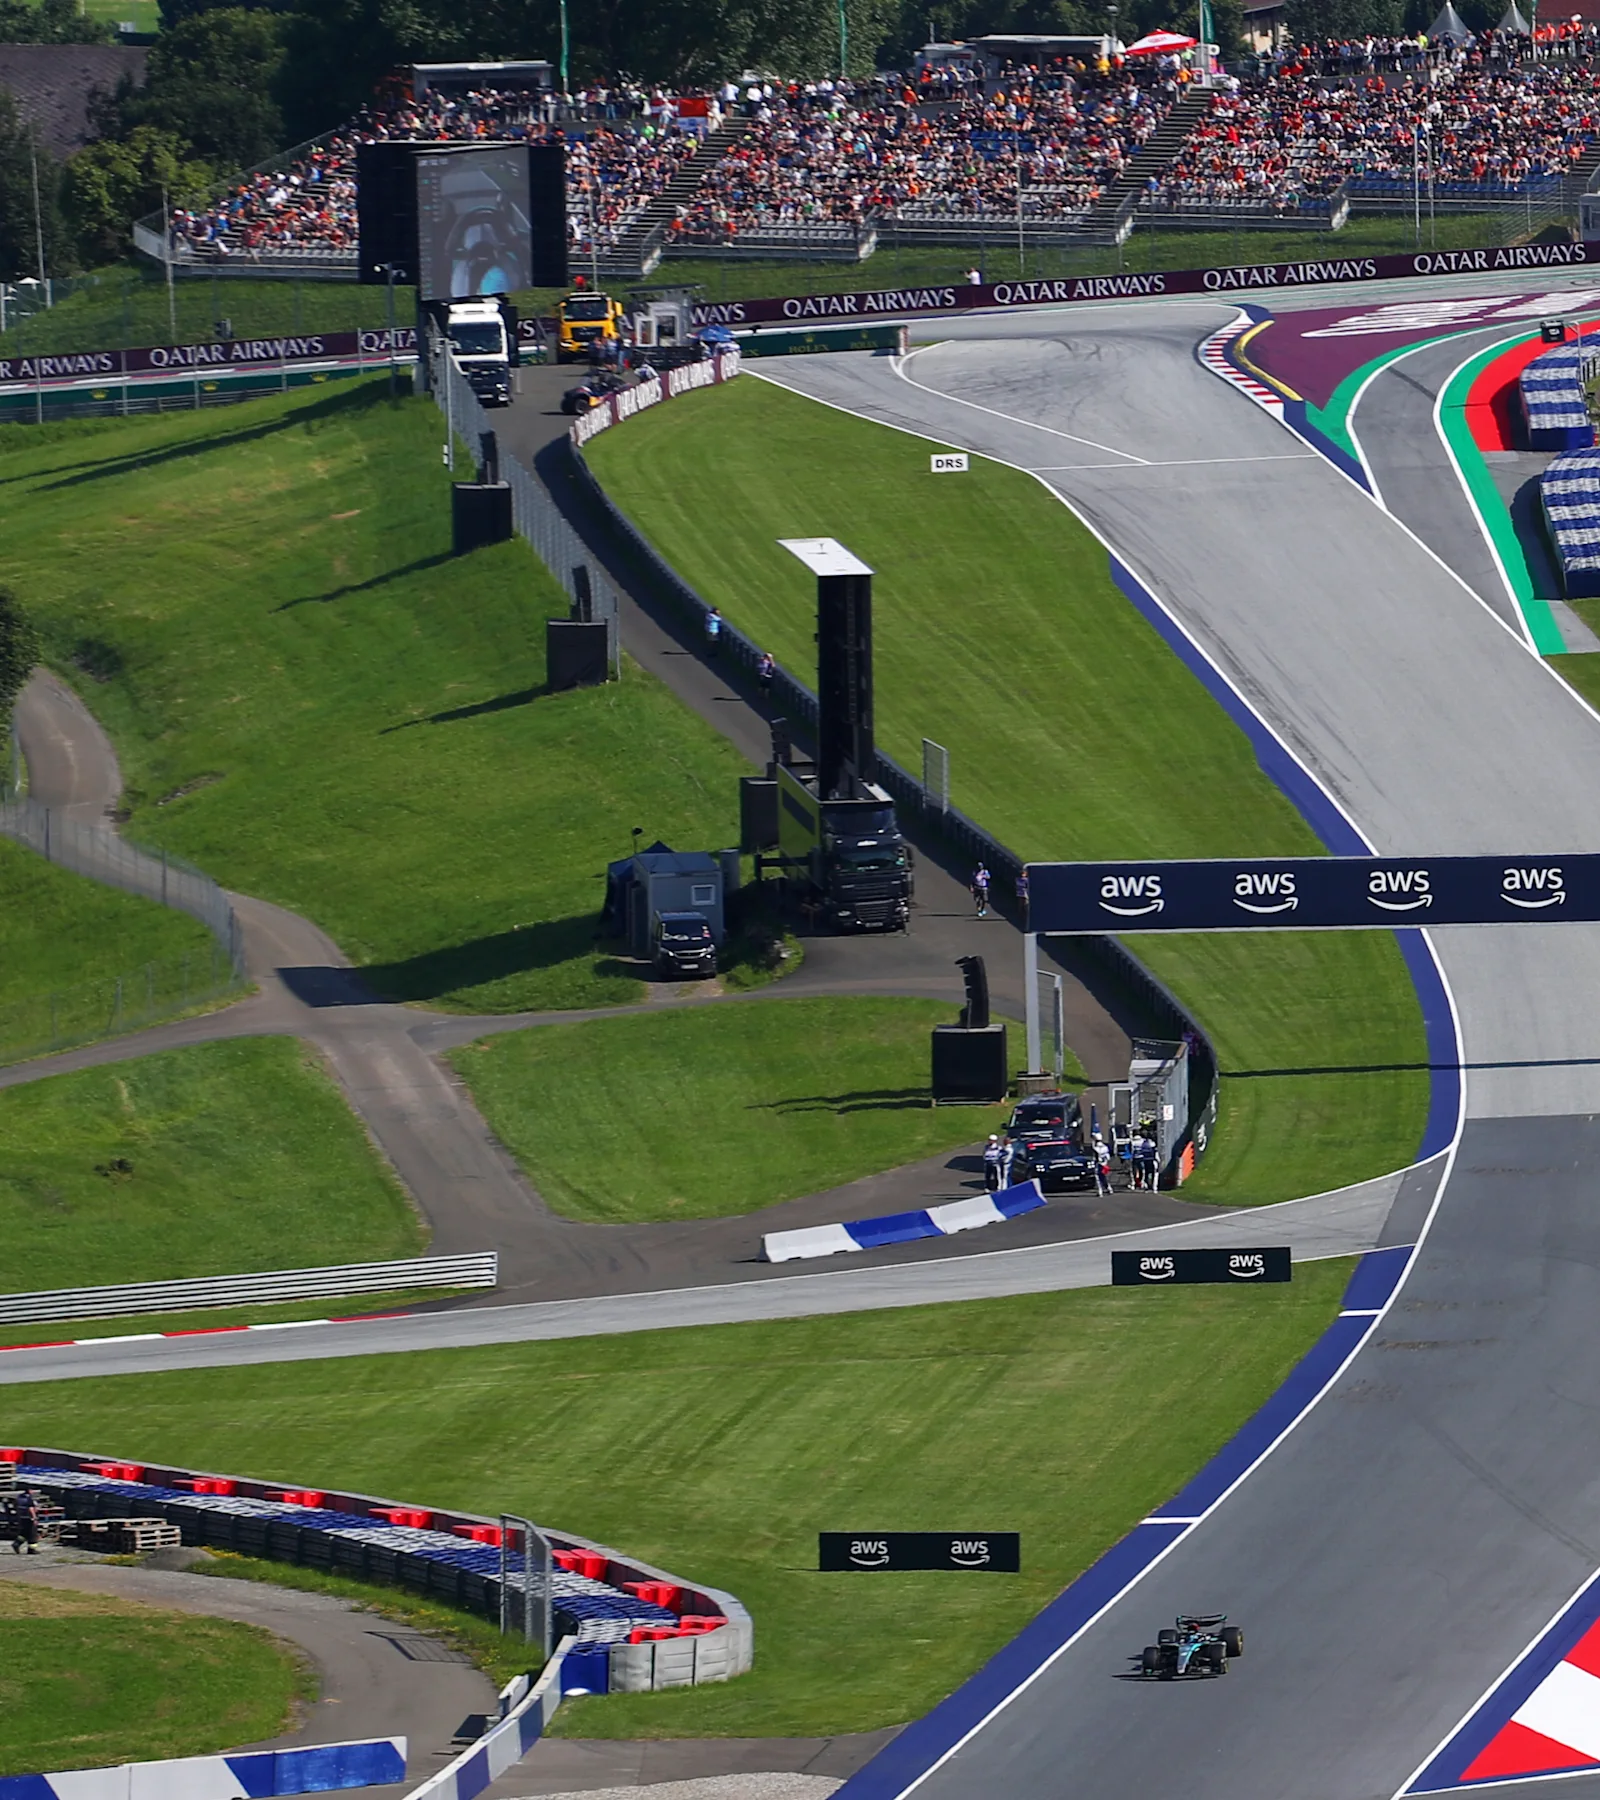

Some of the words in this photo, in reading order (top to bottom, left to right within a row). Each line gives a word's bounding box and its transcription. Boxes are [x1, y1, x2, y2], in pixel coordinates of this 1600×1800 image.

[1413, 251, 1488, 274] QATAR
[1494, 243, 1587, 267] AIRWAYS
[1203, 267, 1280, 291] QATAR
[1283, 259, 1377, 283] AIRWAYS
[993, 281, 1068, 305] QATAR
[1073, 274, 1166, 298] AIRWAYS
[783, 295, 857, 318] QATAR
[863, 288, 956, 312] AIRWAYS
[150, 344, 227, 367] QATAR
[230, 336, 324, 362] AIRWAYS
[361, 329, 417, 351] QATA
[19, 352, 113, 377] AIRWAYS
[935, 458, 964, 469] DRS
[1100, 875, 1162, 898] aws
[1234, 873, 1296, 896] aws
[1368, 870, 1430, 893] aws
[1502, 867, 1563, 890] aws
[1140, 1256, 1174, 1270] aws
[1229, 1254, 1263, 1268] aws
[850, 1540, 888, 1554] aws
[951, 1540, 989, 1554] aws
